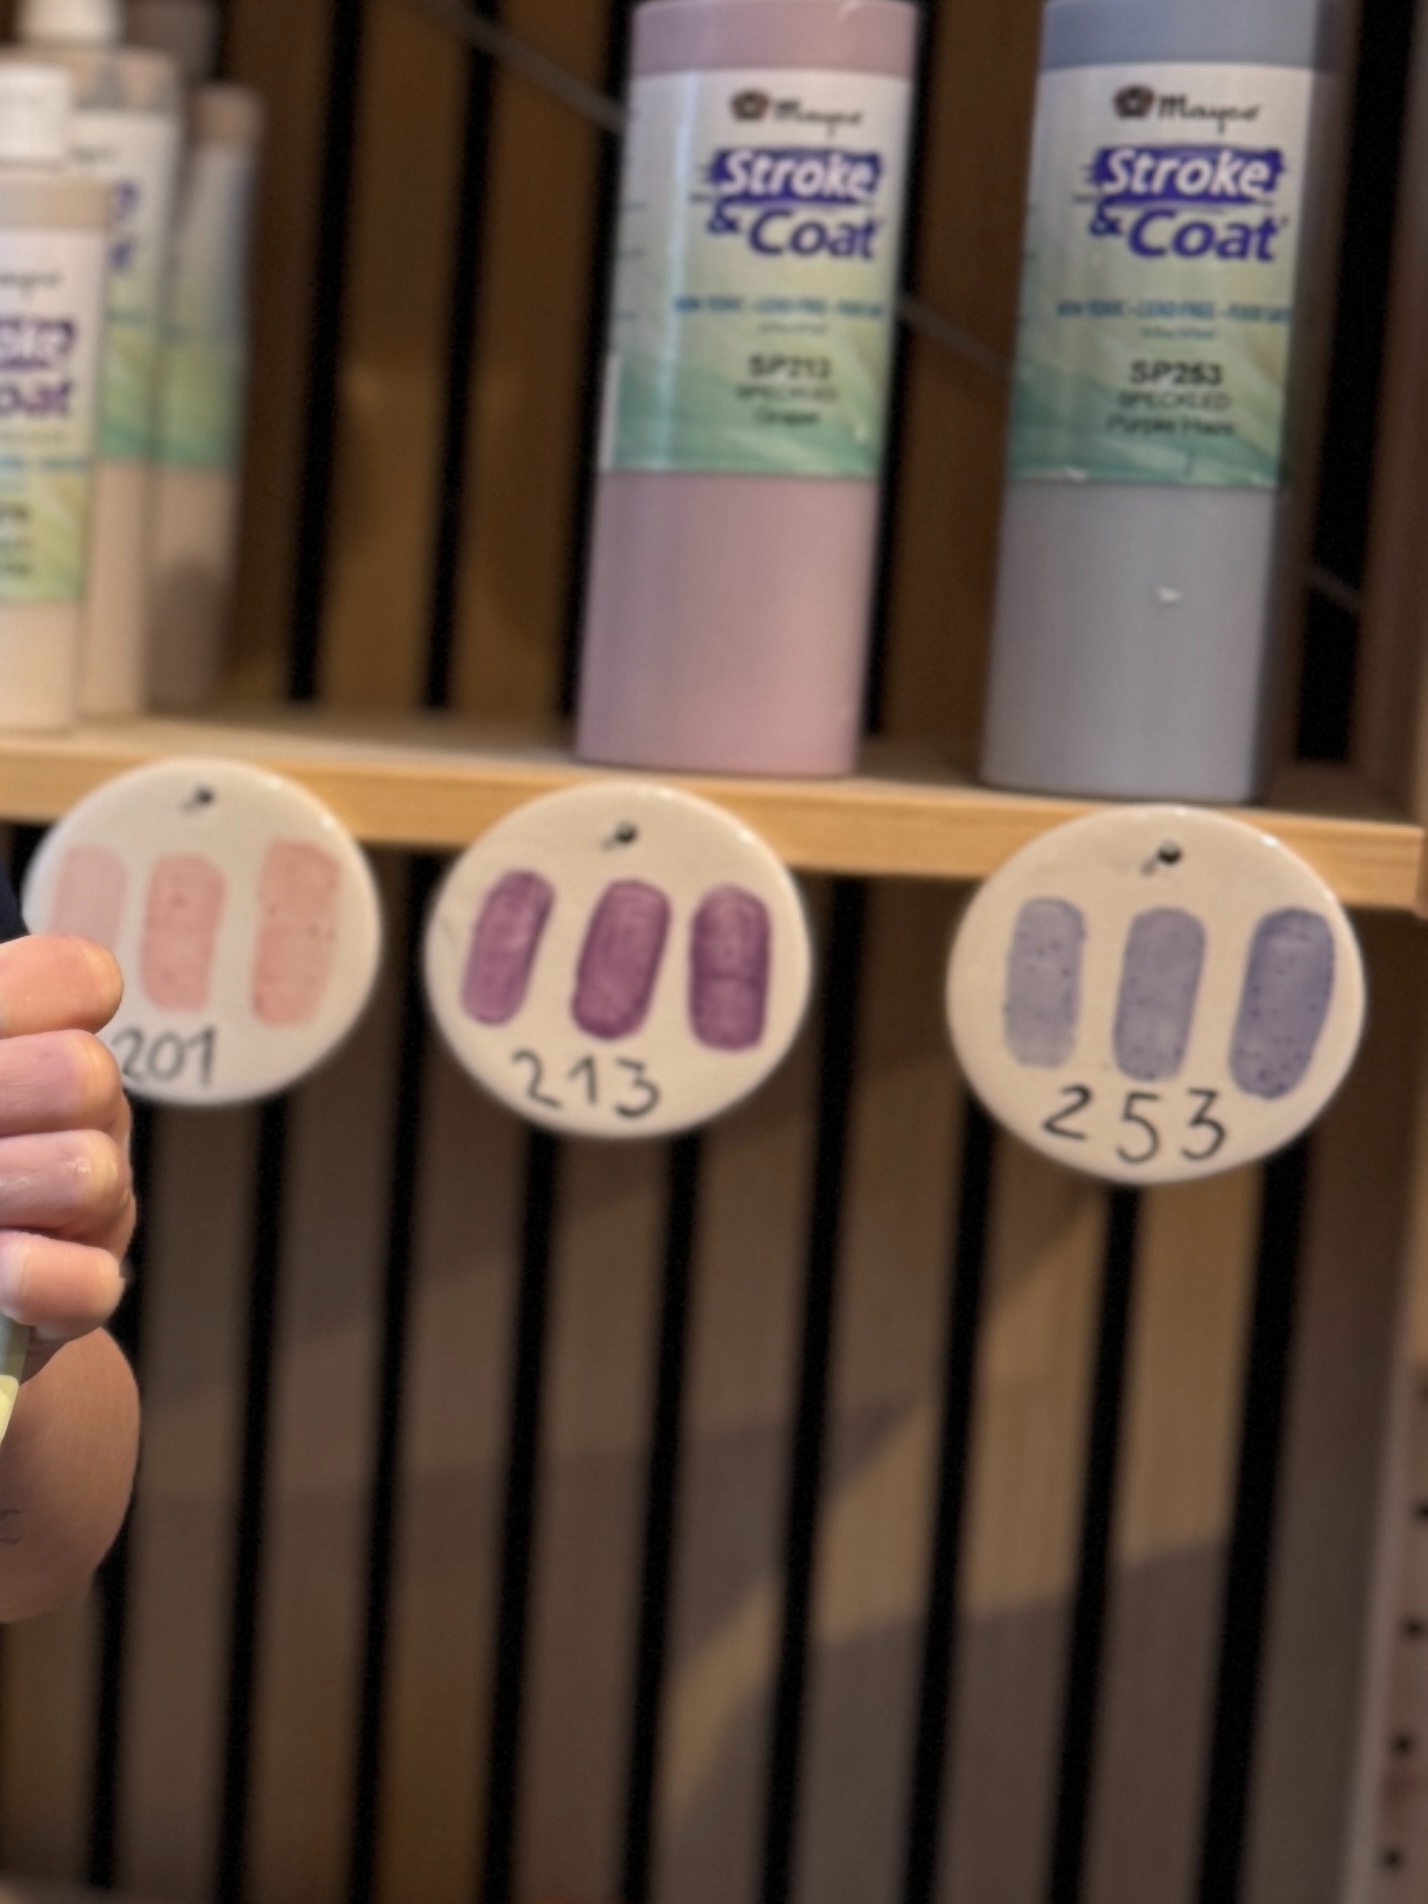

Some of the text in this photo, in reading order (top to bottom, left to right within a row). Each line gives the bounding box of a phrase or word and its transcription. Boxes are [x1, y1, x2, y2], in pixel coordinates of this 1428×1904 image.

[1157, 93, 1262, 136] Mayco
[717, 147, 876, 200] Stroke
[1101, 146, 1272, 198] Stroke
[749, 206, 879, 262] Coat
[1088, 198, 1281, 263] & Coat
[1129, 359, 1224, 387] SP253
[110, 1024, 216, 1089] 201
[510, 1047, 661, 1121] 213
[1040, 1082, 1227, 1164] 253
